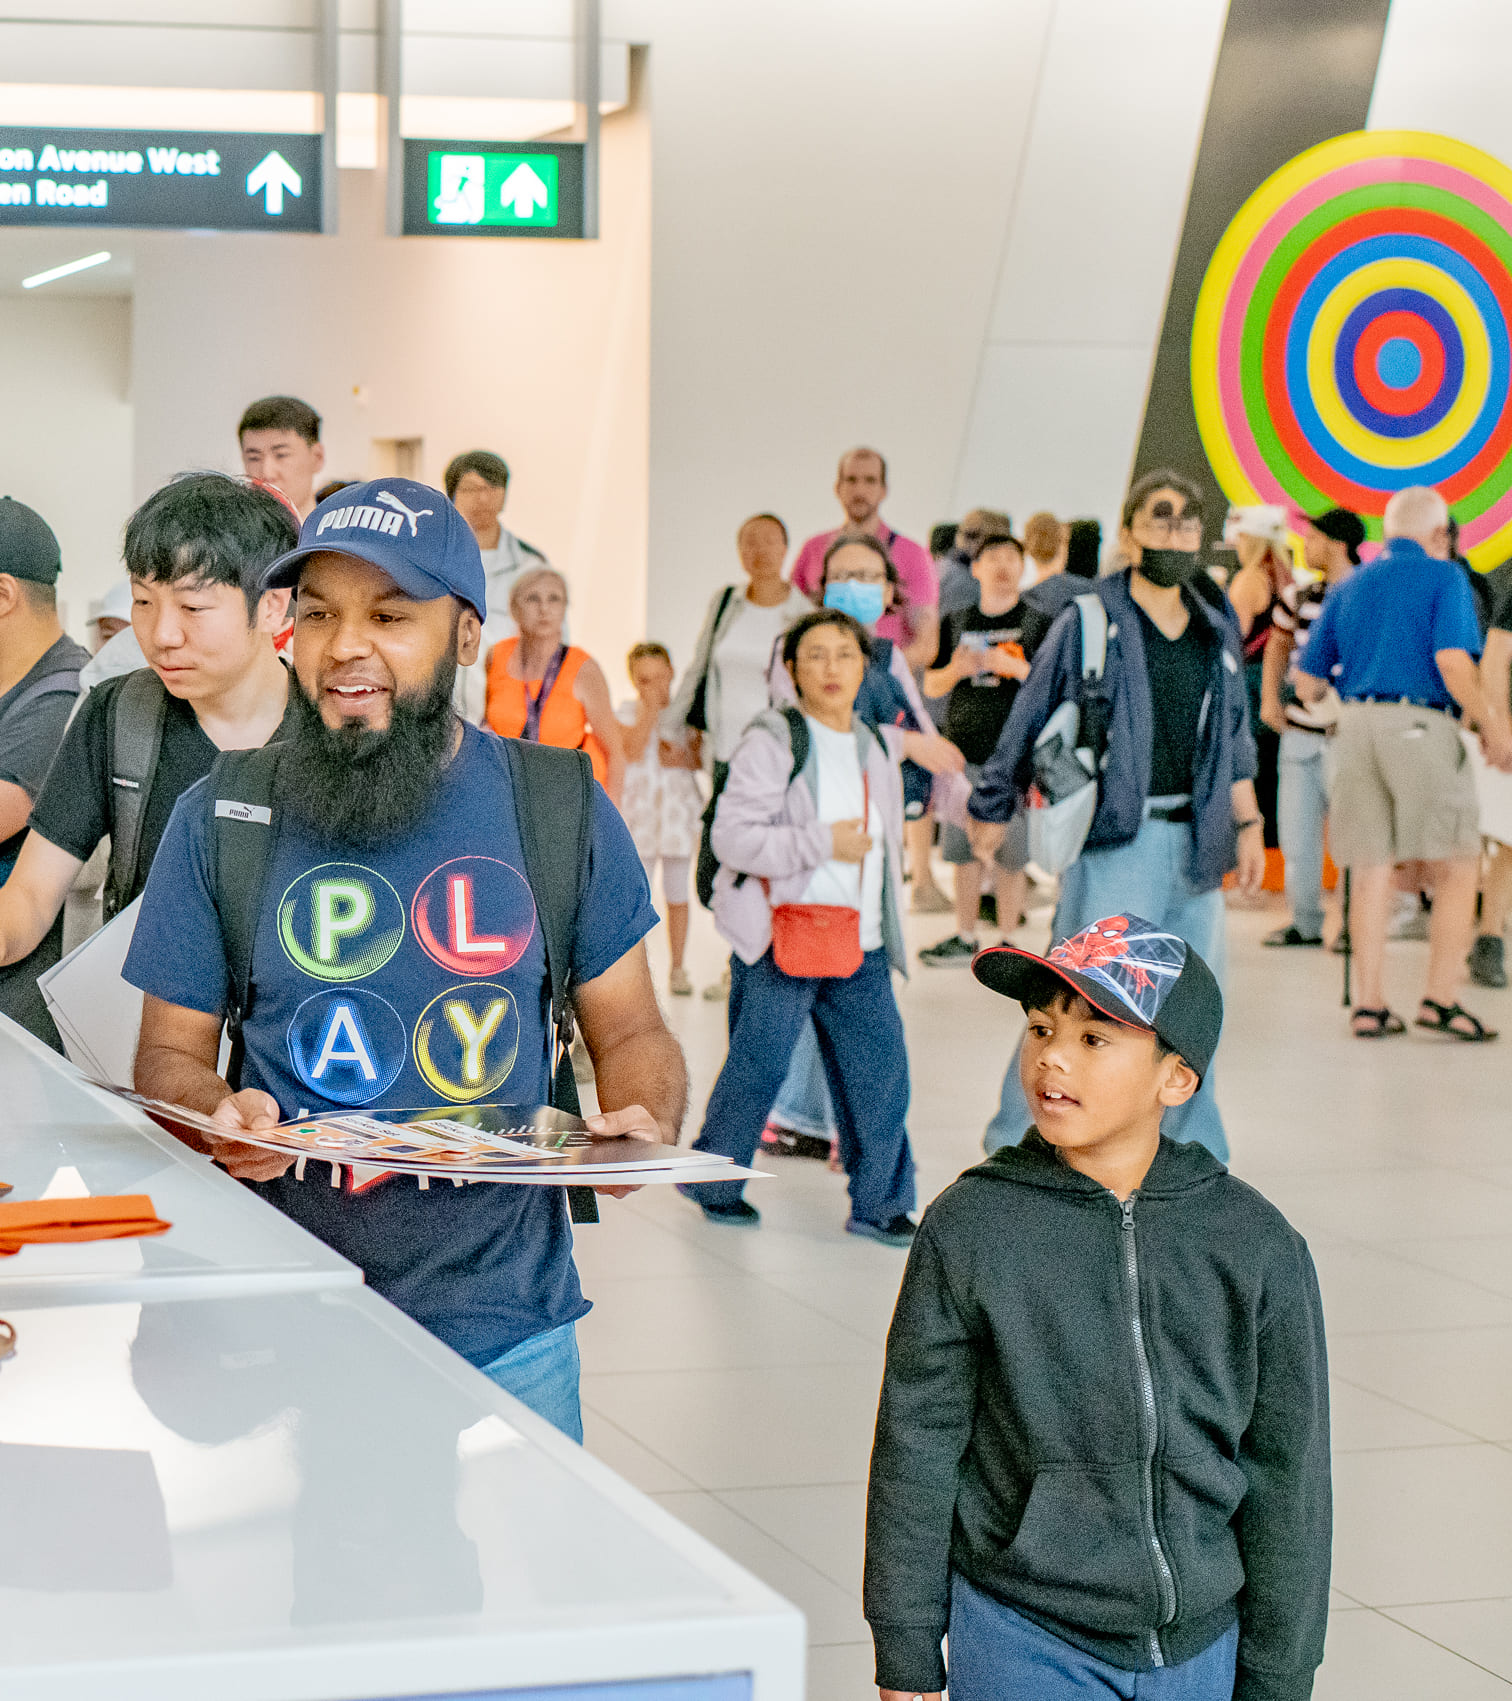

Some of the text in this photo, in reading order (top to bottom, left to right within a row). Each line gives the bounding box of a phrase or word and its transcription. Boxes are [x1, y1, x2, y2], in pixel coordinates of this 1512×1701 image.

[37, 144, 144, 174] Avenue
[146, 147, 221, 176] West
[35, 178, 108, 207] Road
[316, 505, 405, 537] PUMA
[229, 808, 250, 818] PUMA
